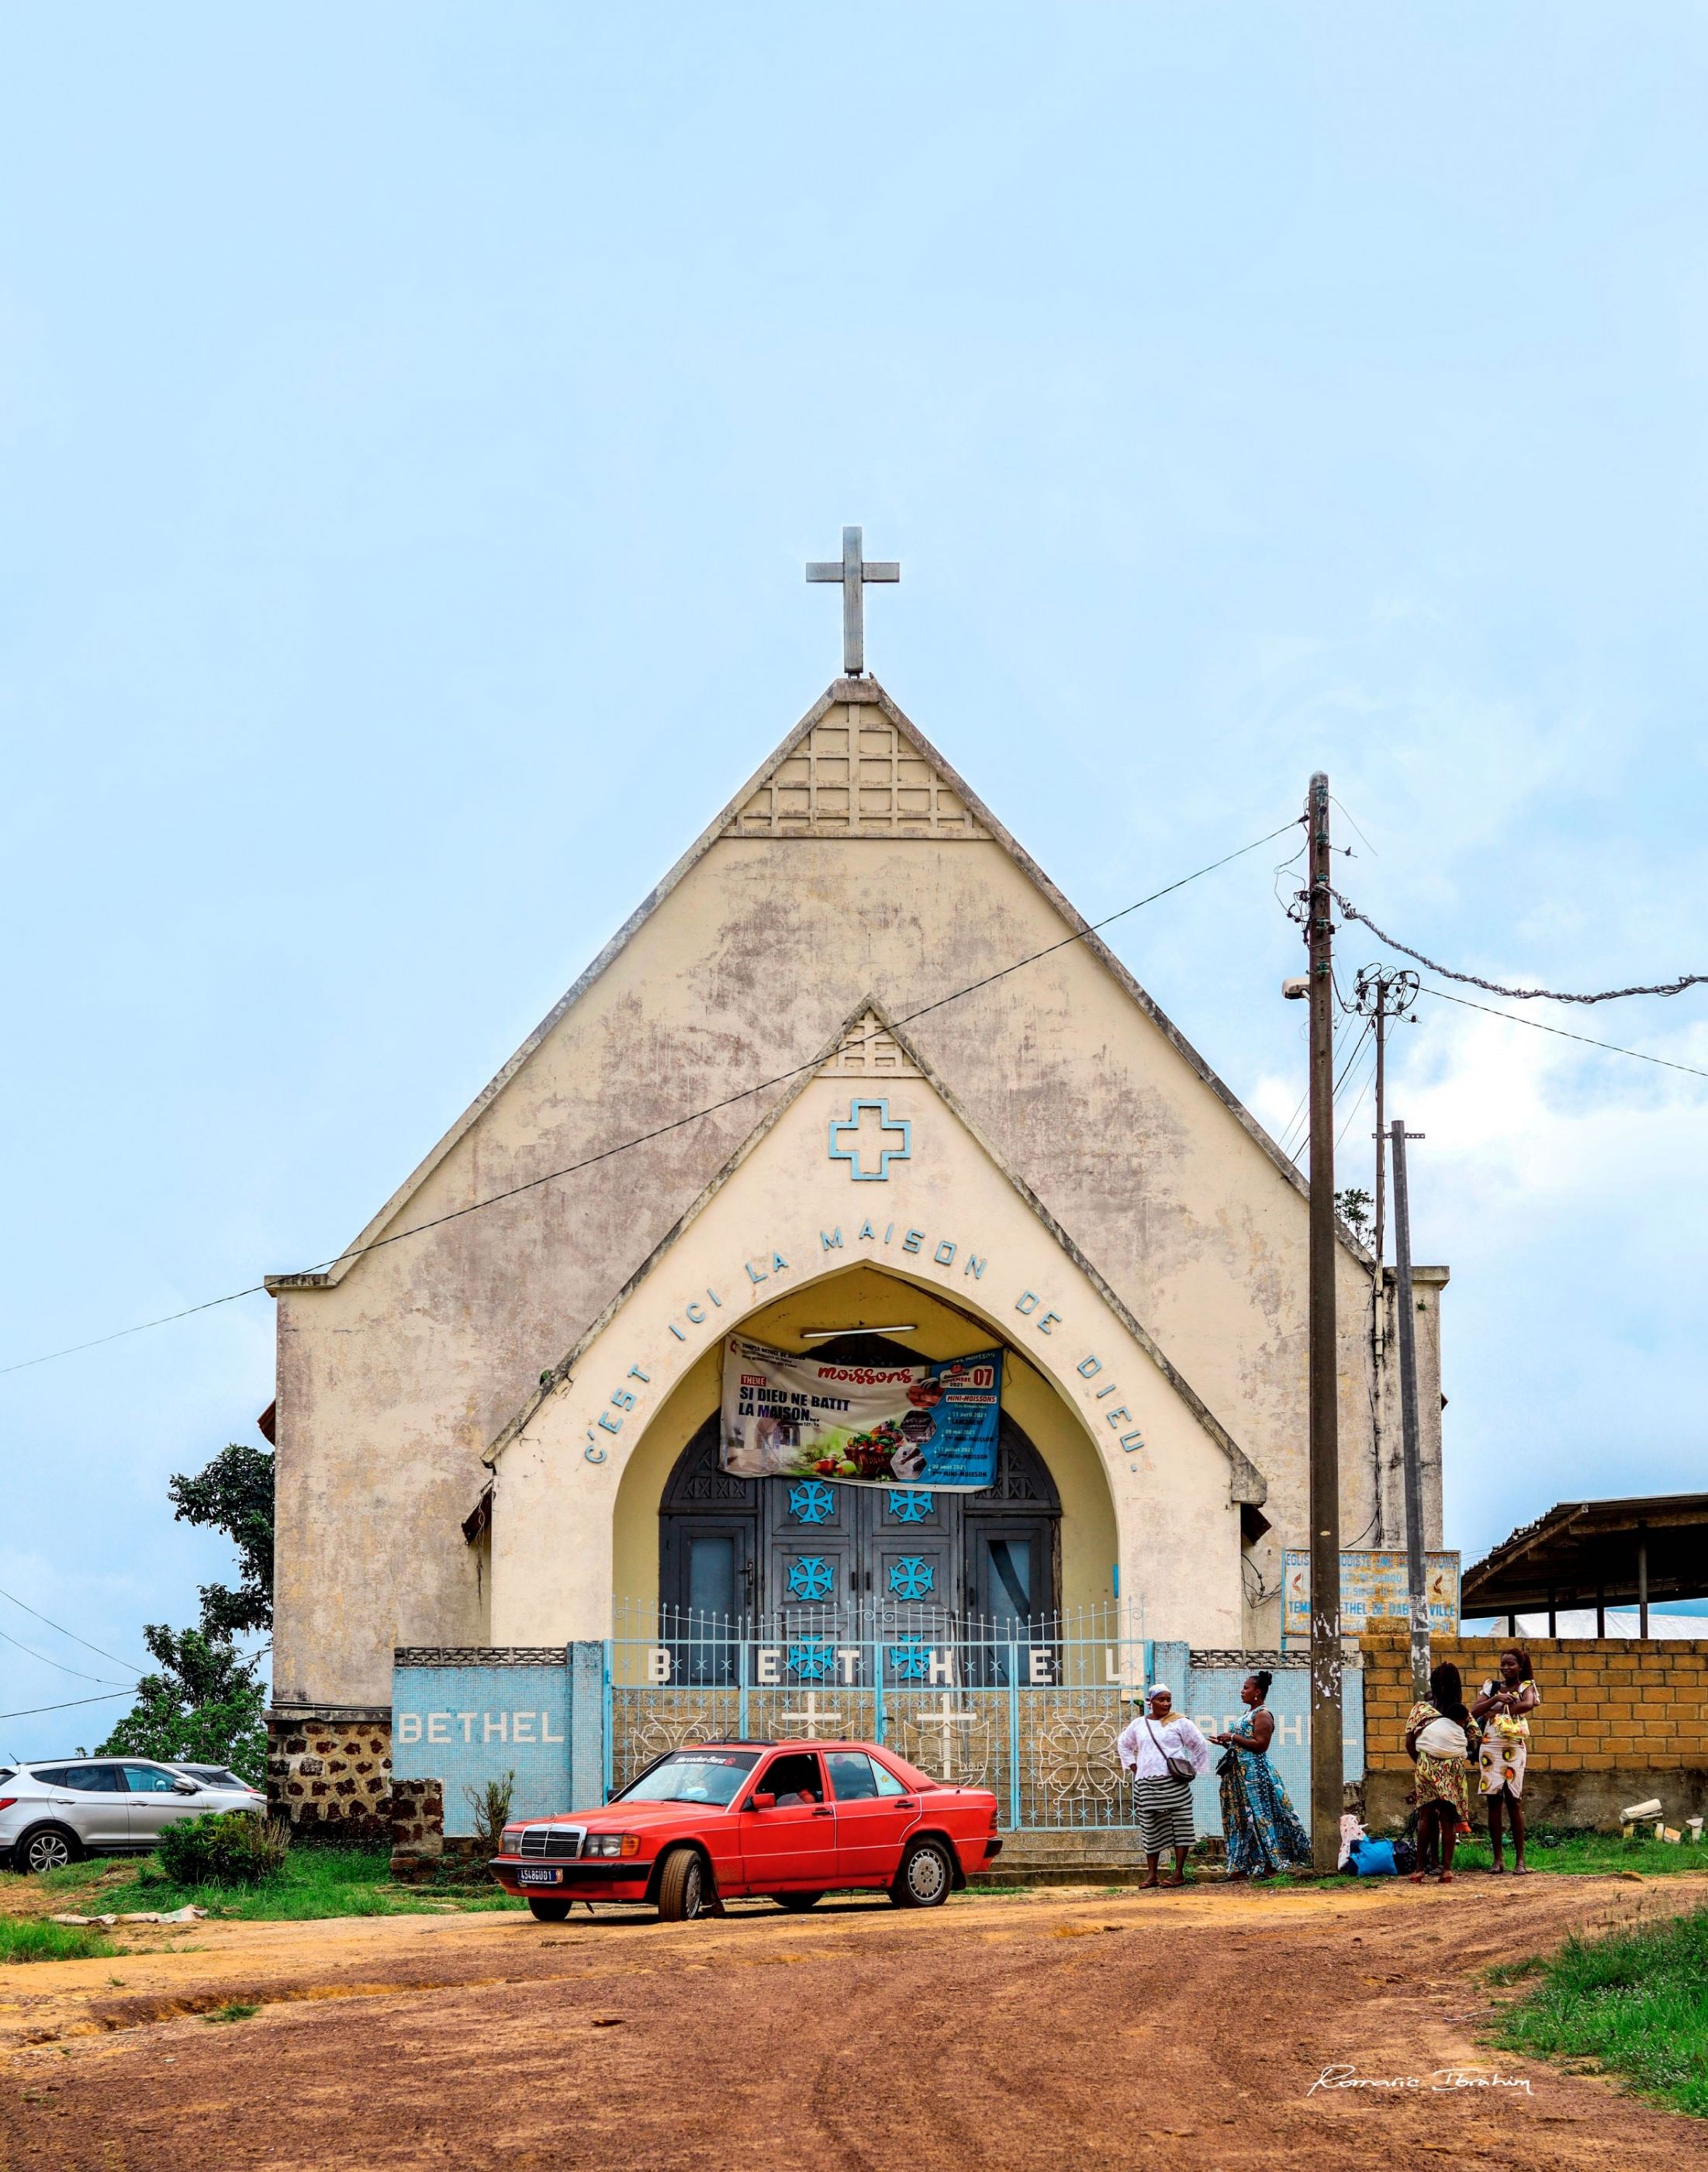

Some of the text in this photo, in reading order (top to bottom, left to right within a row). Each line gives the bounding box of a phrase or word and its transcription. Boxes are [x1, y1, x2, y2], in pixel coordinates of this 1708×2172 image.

[585, 1363, 650, 1464] C'EST
[669, 1288, 722, 1340] ICI
[745, 1250, 789, 1284] LA
[820, 1219, 987, 1280] MAISON
[1015, 1290, 1062, 1334] DE
[818, 1367, 913, 1385] moissons
[973, 1368, 992, 1386] 07
[740, 1386, 851, 1411] SI DIEU NE BATIT
[738, 1402, 754, 1416] LA
[1285, 1553, 1310, 1566] EGLIS
[1389, 1602, 1409, 1615] DAB
[399, 1712, 565, 1744] BETHEL
